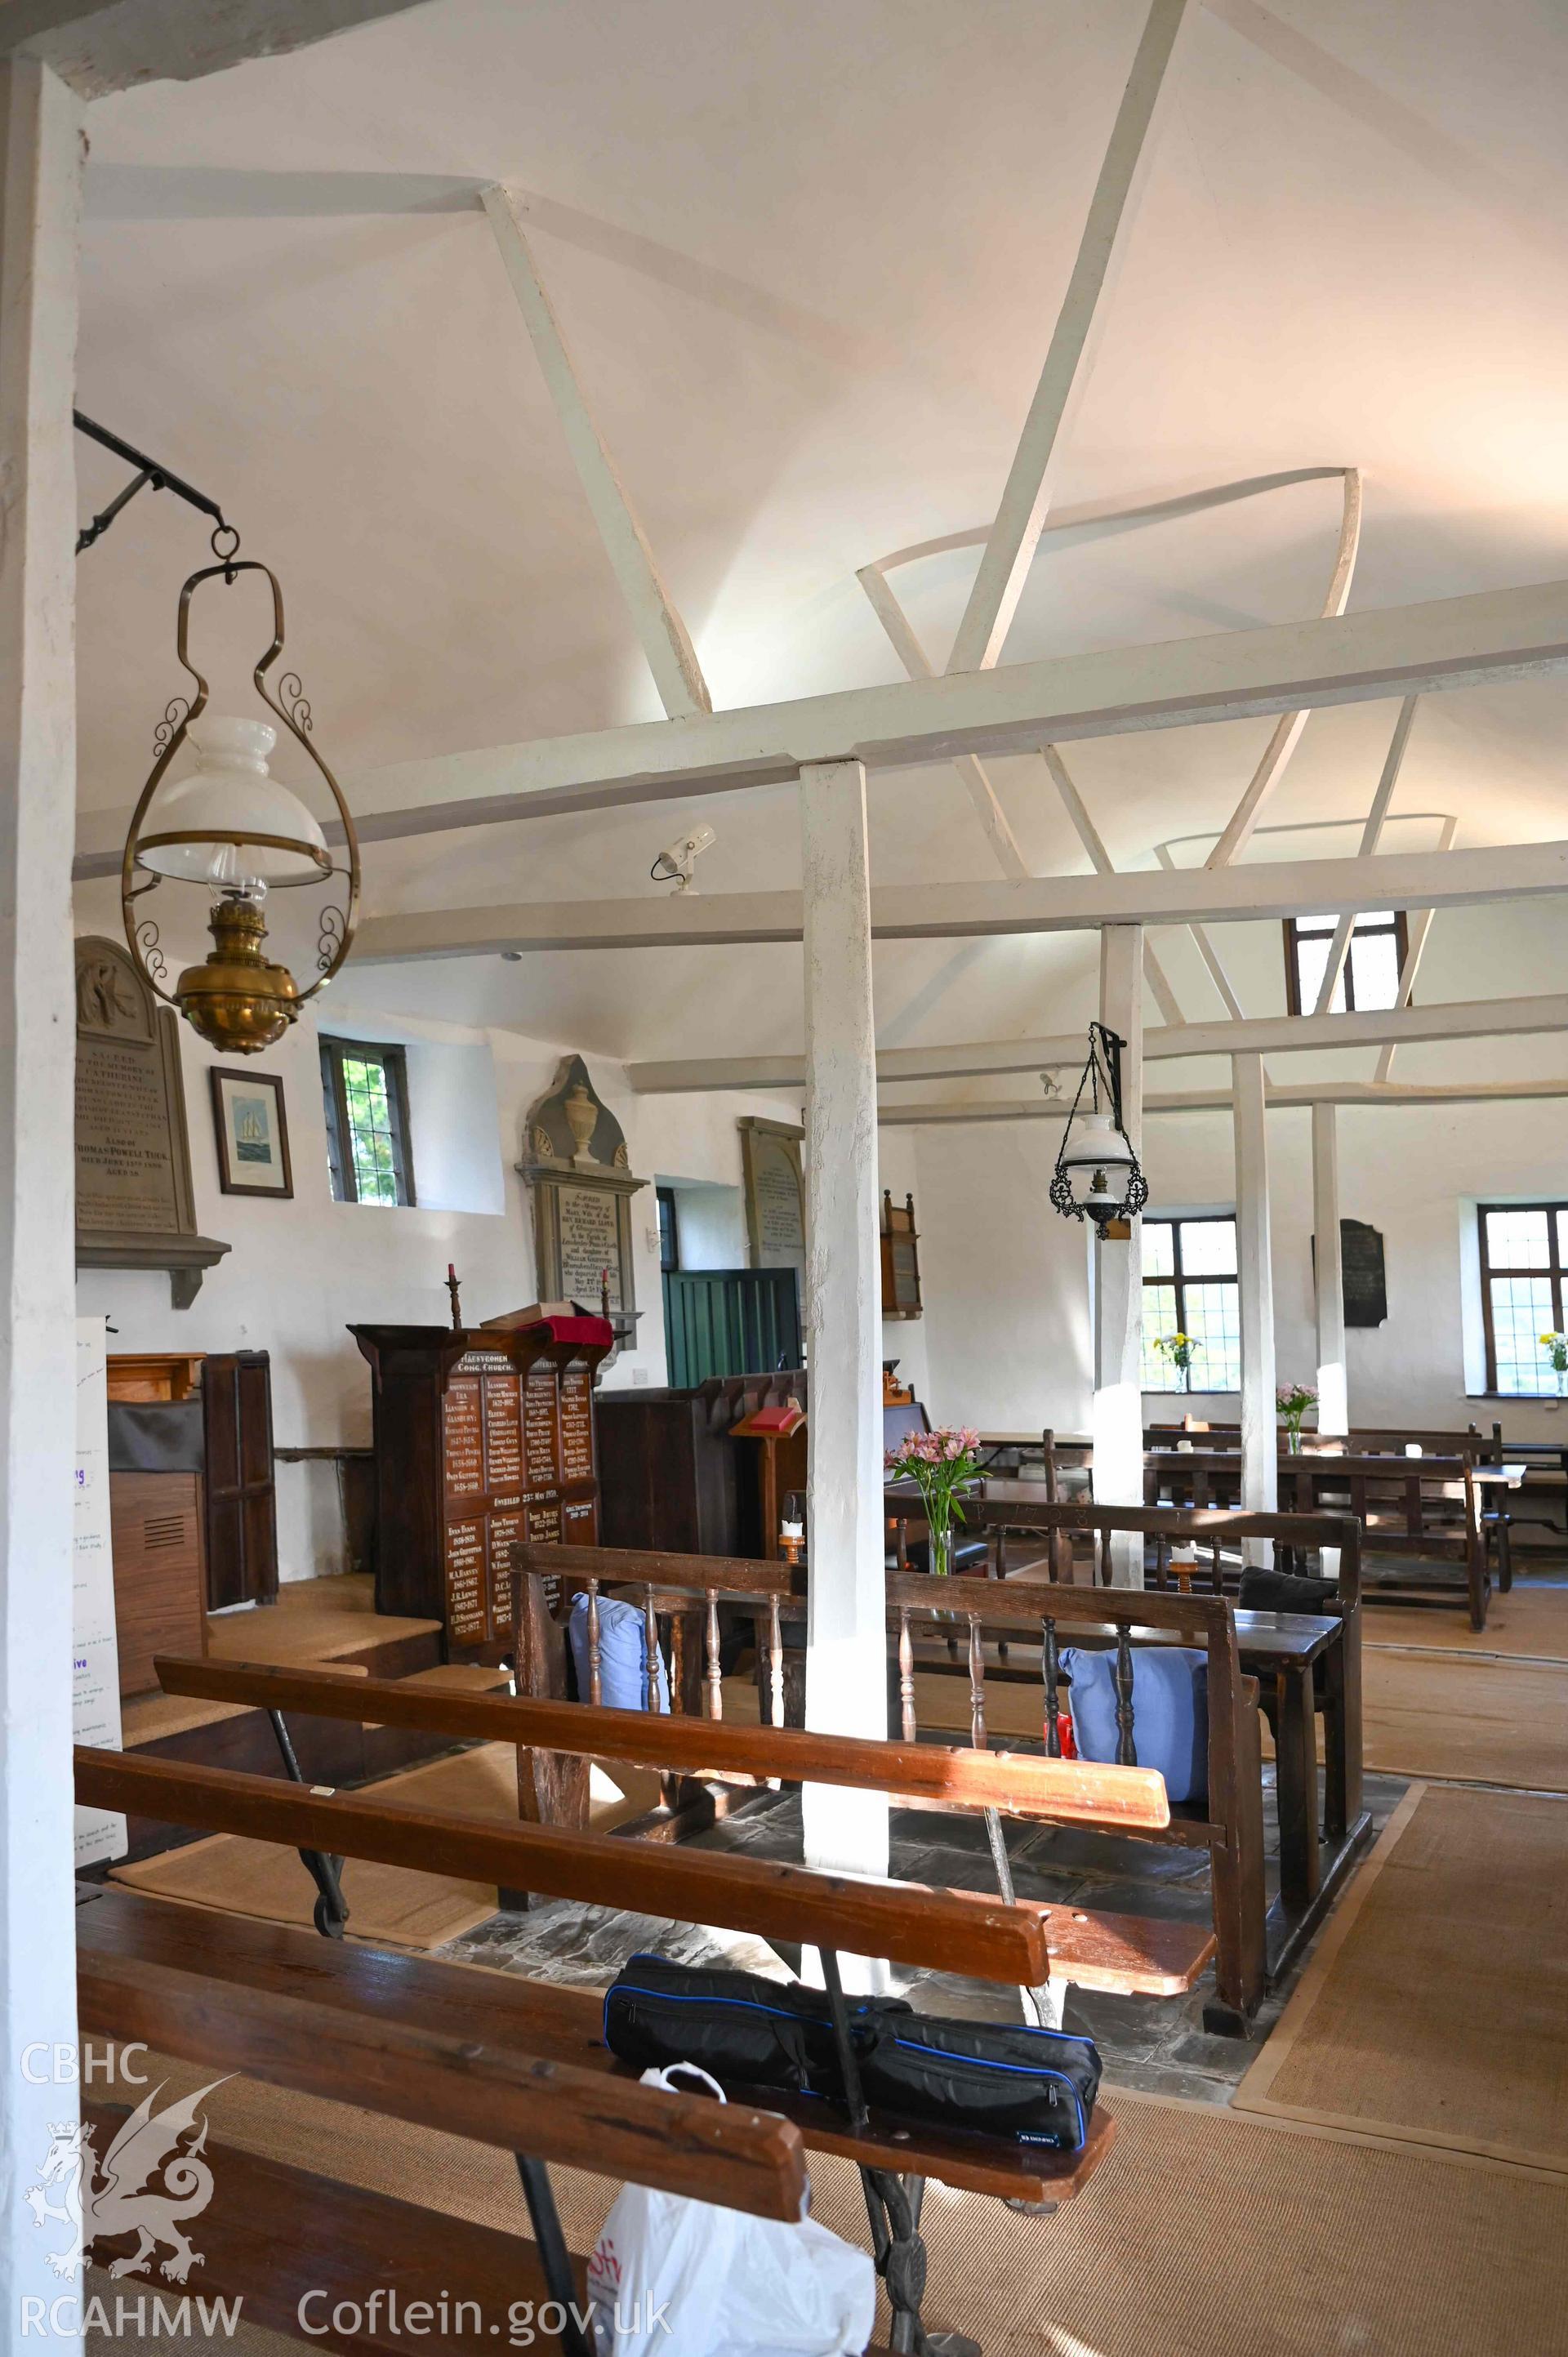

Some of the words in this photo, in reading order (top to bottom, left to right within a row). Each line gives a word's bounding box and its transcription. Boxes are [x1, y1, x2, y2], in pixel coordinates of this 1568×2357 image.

[110, 1146, 144, 1158] POWELL
[457, 1363, 482, 1372] CONG.
[483, 1363, 514, 1371] CHURCH.
[74, 1659, 87, 1670] ive
